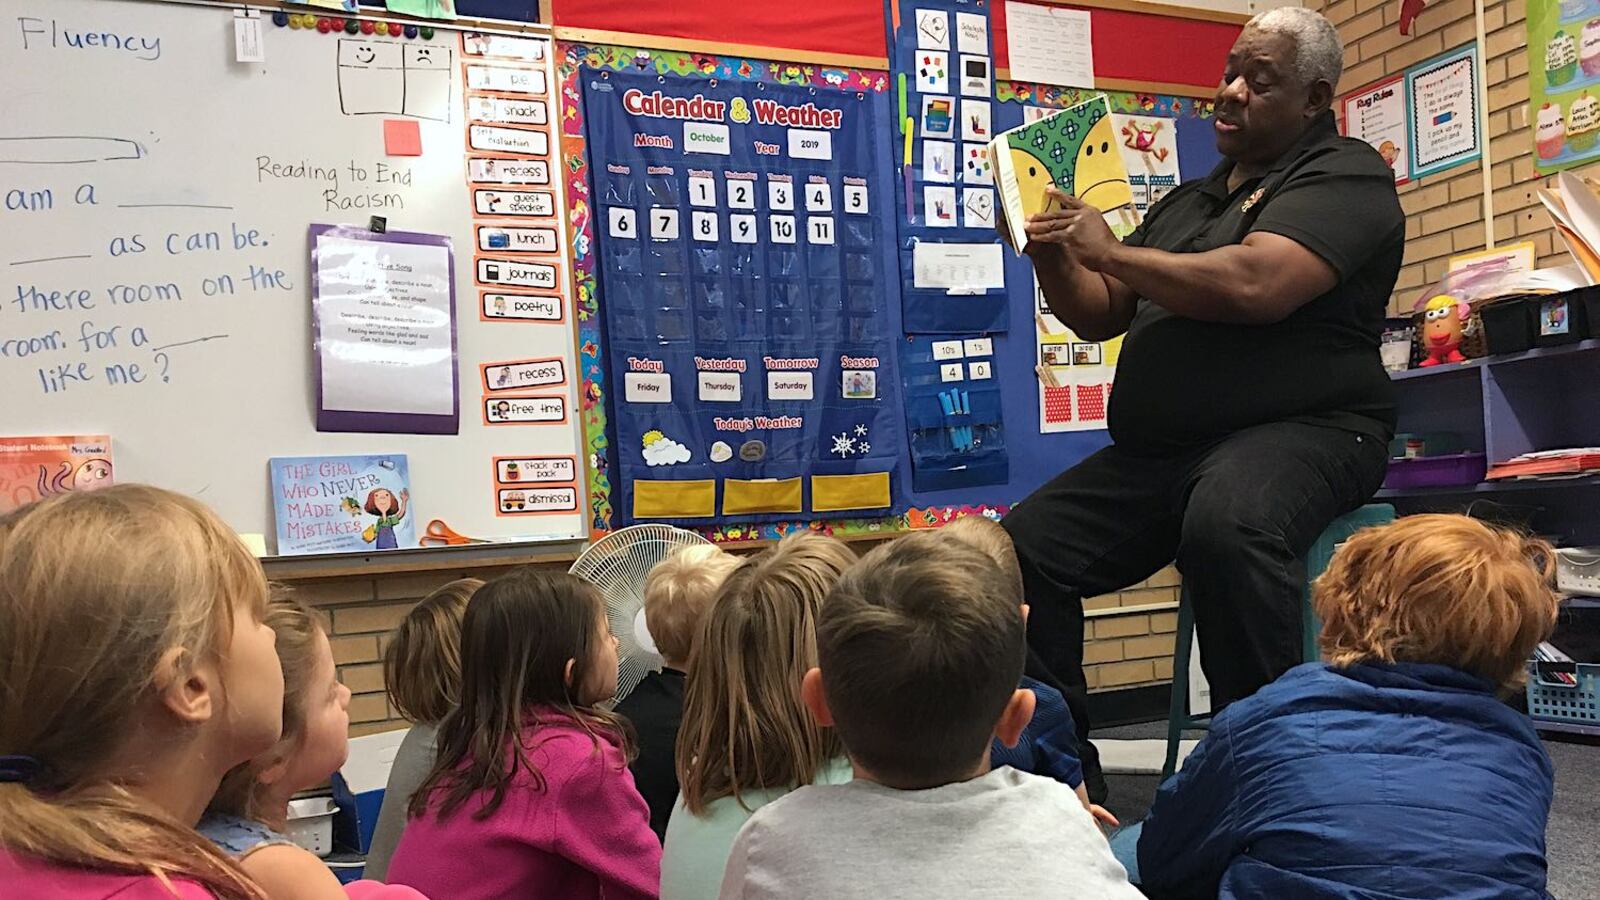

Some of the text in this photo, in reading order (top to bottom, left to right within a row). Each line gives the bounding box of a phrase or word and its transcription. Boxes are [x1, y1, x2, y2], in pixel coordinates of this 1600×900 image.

[17, 17, 161, 60] Fluency
[1357, 89, 1394, 109] Rug Rules
[504, 106, 537, 117] snack
[623, 89, 842, 128] Calendar & Weather
[488, 137, 530, 148] evaluation
[634, 132, 725, 149] Month October
[754, 139, 819, 155] Year 2019
[256, 155, 412, 192] Reading to End
[504, 166, 542, 177] recess
[647, 166, 674, 176] Monday
[6, 184, 99, 211] am a
[513, 194, 540, 203] guest
[699, 185, 706, 200] 1
[736, 187, 746, 202] 2
[776, 188, 786, 204] 3
[814, 190, 824, 206] 4
[852, 192, 861, 207] 5
[323, 189, 404, 212] Racism
[509, 203, 545, 213] speaker
[617, 215, 628, 231] 6
[659, 216, 670, 232] 7
[701, 219, 711, 235] 8
[739, 221, 749, 236] 9
[775, 222, 791, 237] 10
[815, 223, 828, 238] 11
[110, 234, 146, 257] as
[167, 230, 220, 255] can
[516, 233, 545, 245] lunch
[506, 267, 552, 281] journals
[12, 264, 293, 312] there room on the
[514, 300, 553, 316] poetry
[79, 321, 122, 352] for
[131, 327, 149, 347] a
[628, 356, 879, 373] Today Yesterday Tomorrow Season
[977, 365, 984, 376] 0
[38, 362, 94, 393] like
[105, 363, 147, 385] me
[518, 366, 557, 381] recess
[949, 367, 957, 378] 4
[637, 383, 660, 393] Friday
[704, 382, 735, 392] Thursday
[774, 381, 807, 391] Saturday
[511, 404, 562, 415] free time
[714, 416, 802, 431] Today's Weather
[283, 464, 315, 480] THE
[523, 461, 569, 470] stack and
[536, 470, 557, 479] pack
[282, 473, 381, 500] WHO NEVER
[528, 492, 571, 504] dismissal
[287, 502, 335, 519] MADE
